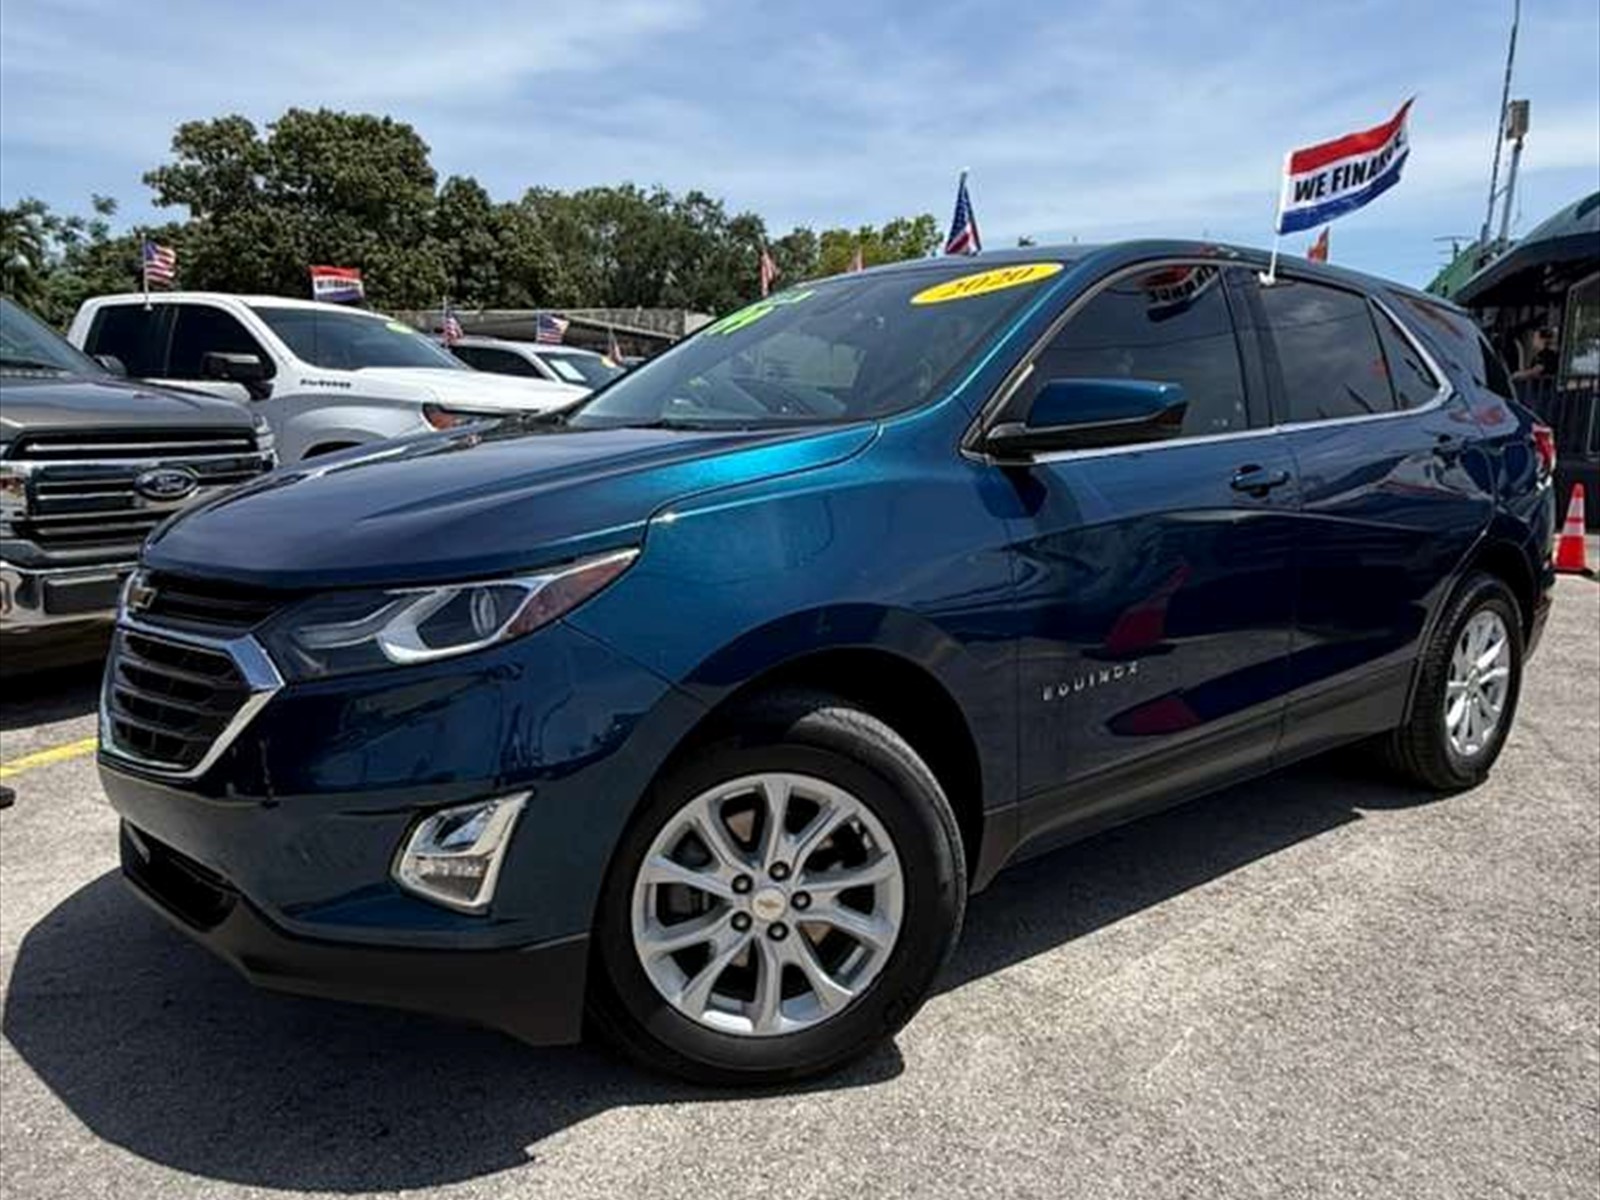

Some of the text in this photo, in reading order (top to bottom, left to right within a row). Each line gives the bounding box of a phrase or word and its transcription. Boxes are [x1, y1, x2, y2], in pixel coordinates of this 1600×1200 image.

[1295, 131, 1402, 202] WE FINANE
[938, 266, 1035, 298] 2020
[1042, 660, 1139, 701] EQUINOX
